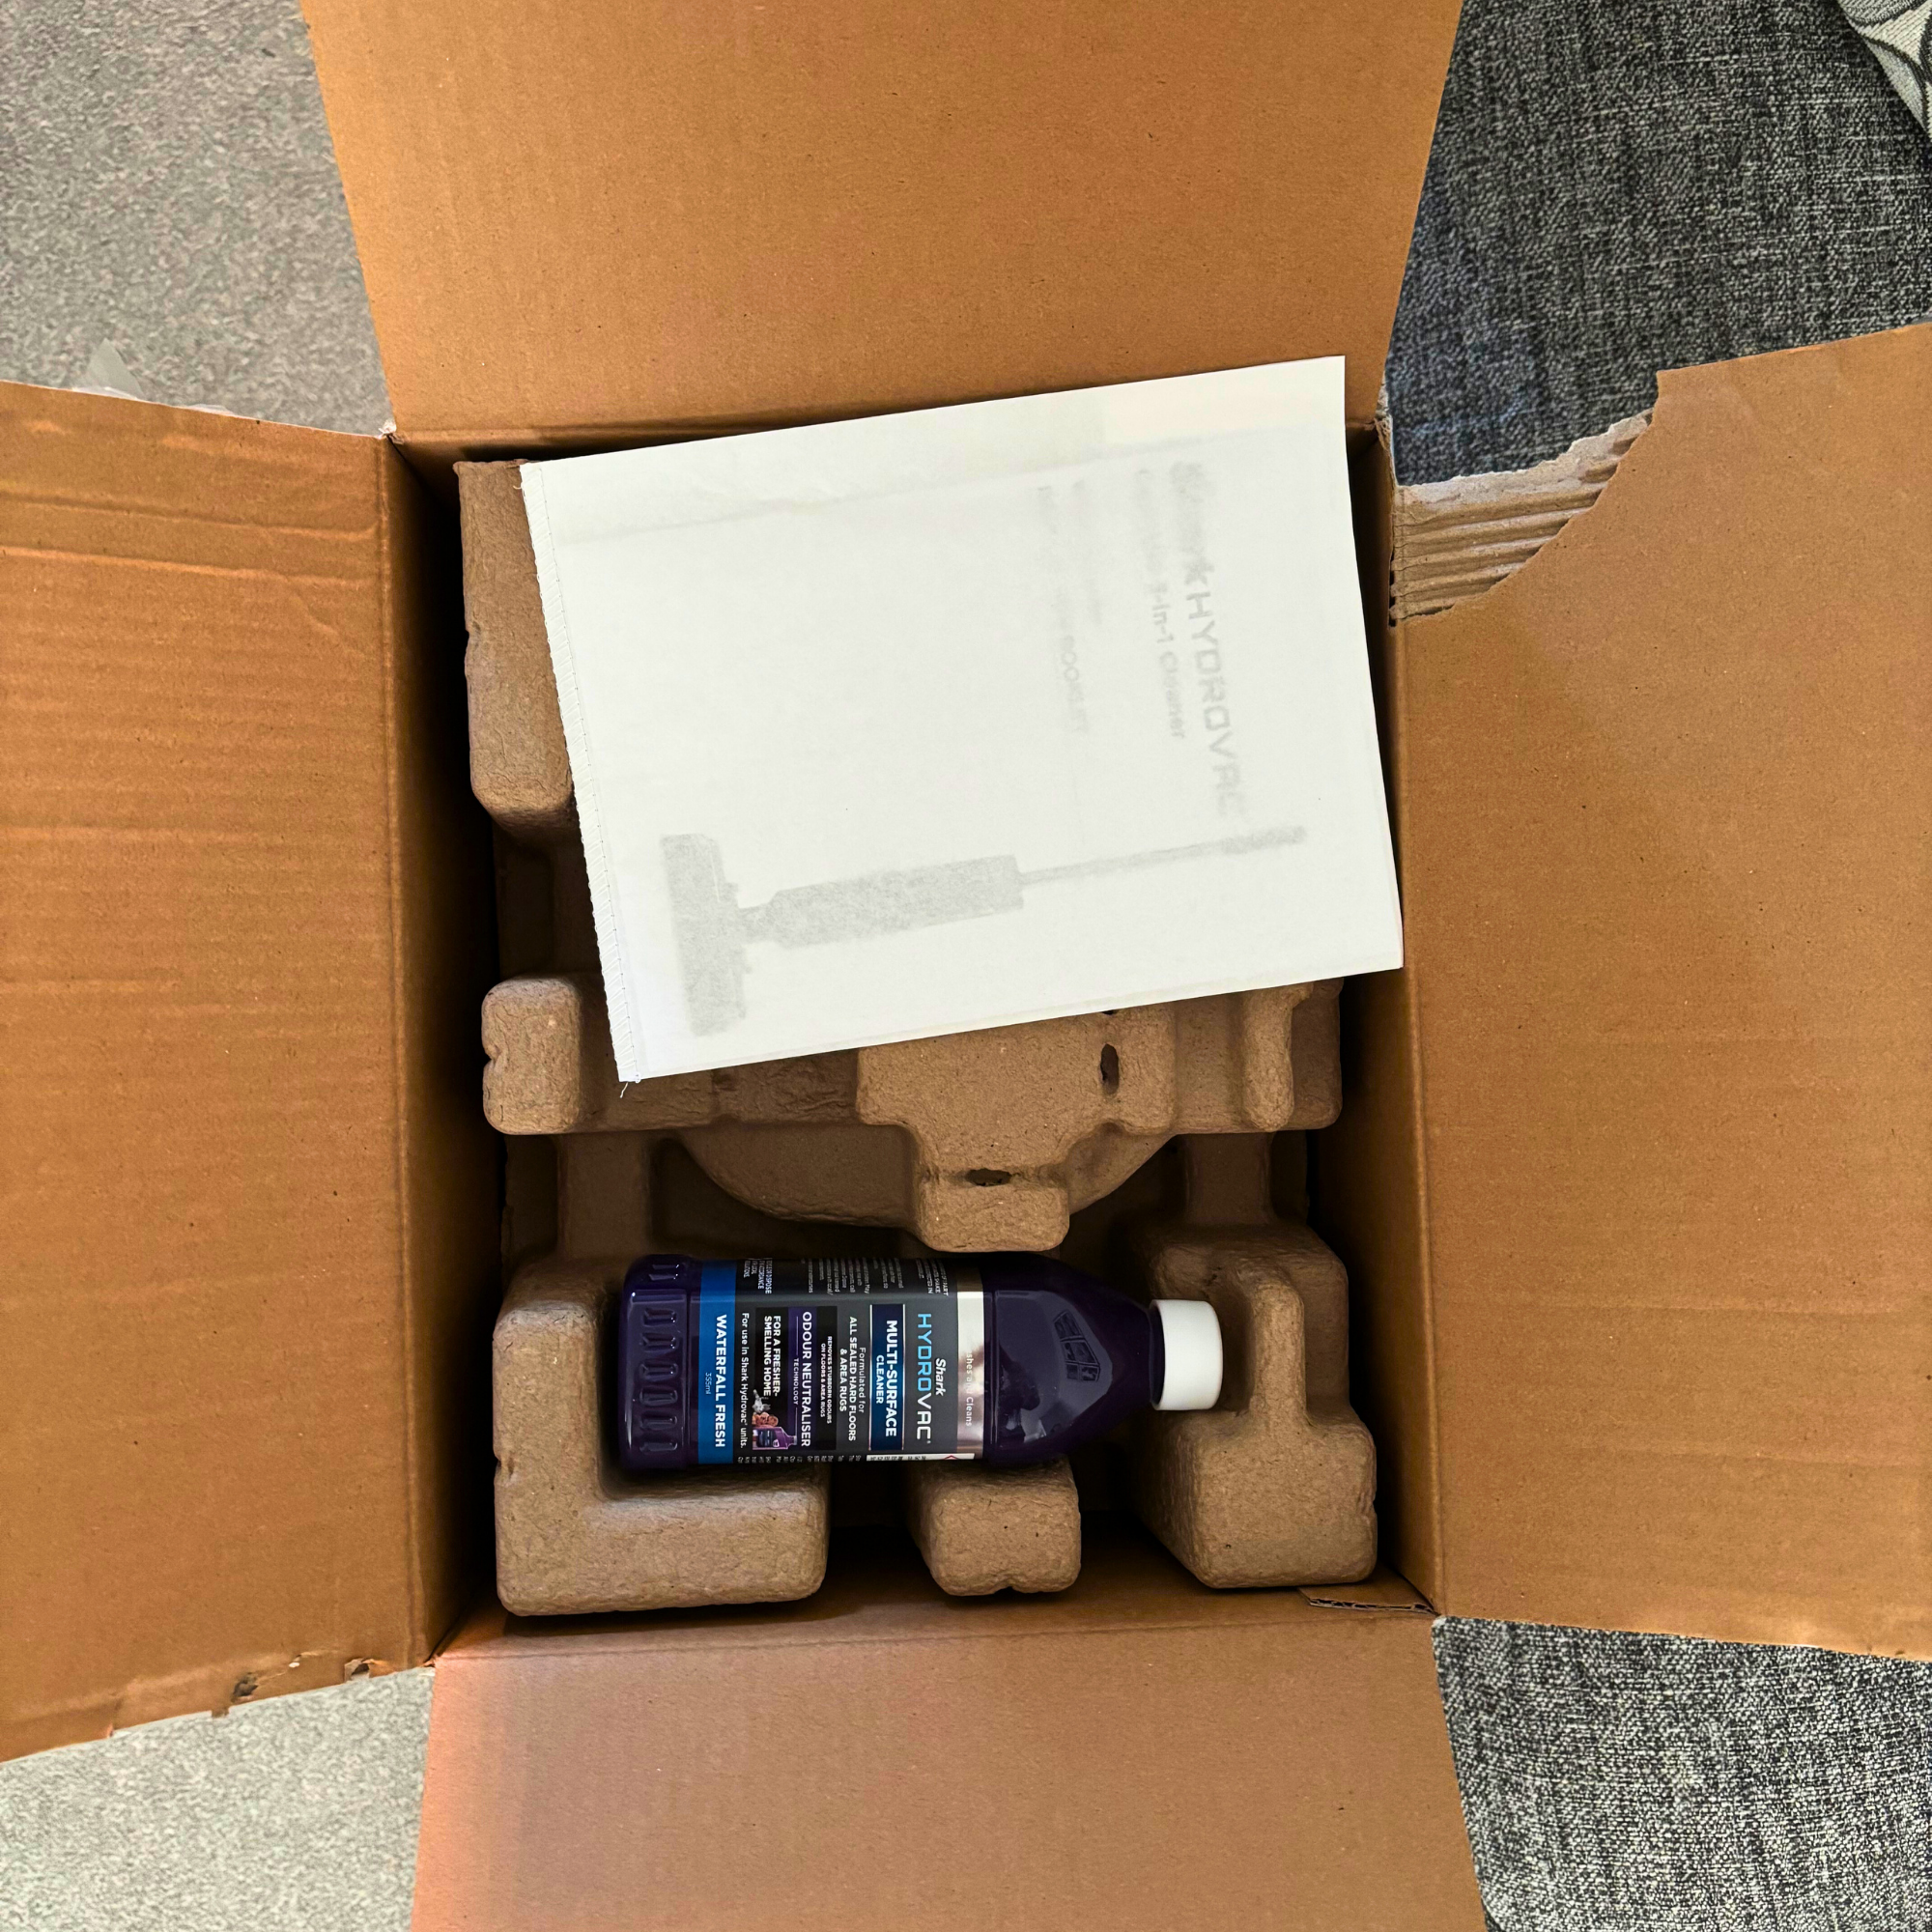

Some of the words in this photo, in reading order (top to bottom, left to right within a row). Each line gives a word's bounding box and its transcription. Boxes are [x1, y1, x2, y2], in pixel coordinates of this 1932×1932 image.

[763, 1315, 772, 1365] SMELLING
[773, 1315, 781, 1337] FOR
[773, 1338, 781, 1347] A
[802, 1311, 812, 1359] ODOUR
[849, 1316, 858, 1336] ALL
[715, 1314, 727, 1402] WATERFALL
[741, 1347, 749, 1355] in
[820, 1343, 826, 1353] ON
[839, 1348, 848, 1356] &
[740, 1356, 749, 1381] Shark
[763, 1367, 772, 1397] HOME
[772, 1348, 781, 1397] FRESHER-
[858, 1347, 867, 1398] Formulated
[875, 1354, 884, 1405] CLEANER
[885, 1320, 898, 1437] MULTI-SURFACE
[934, 1357, 947, 1397] Shark
[801, 1362, 811, 1447] NEUTRALISER
[858, 1400, 867, 1413] for
[965, 1397, 974, 1427] Cleans
[715, 1404, 726, 1448] FRESH
[848, 1405, 857, 1441] FLOORS
